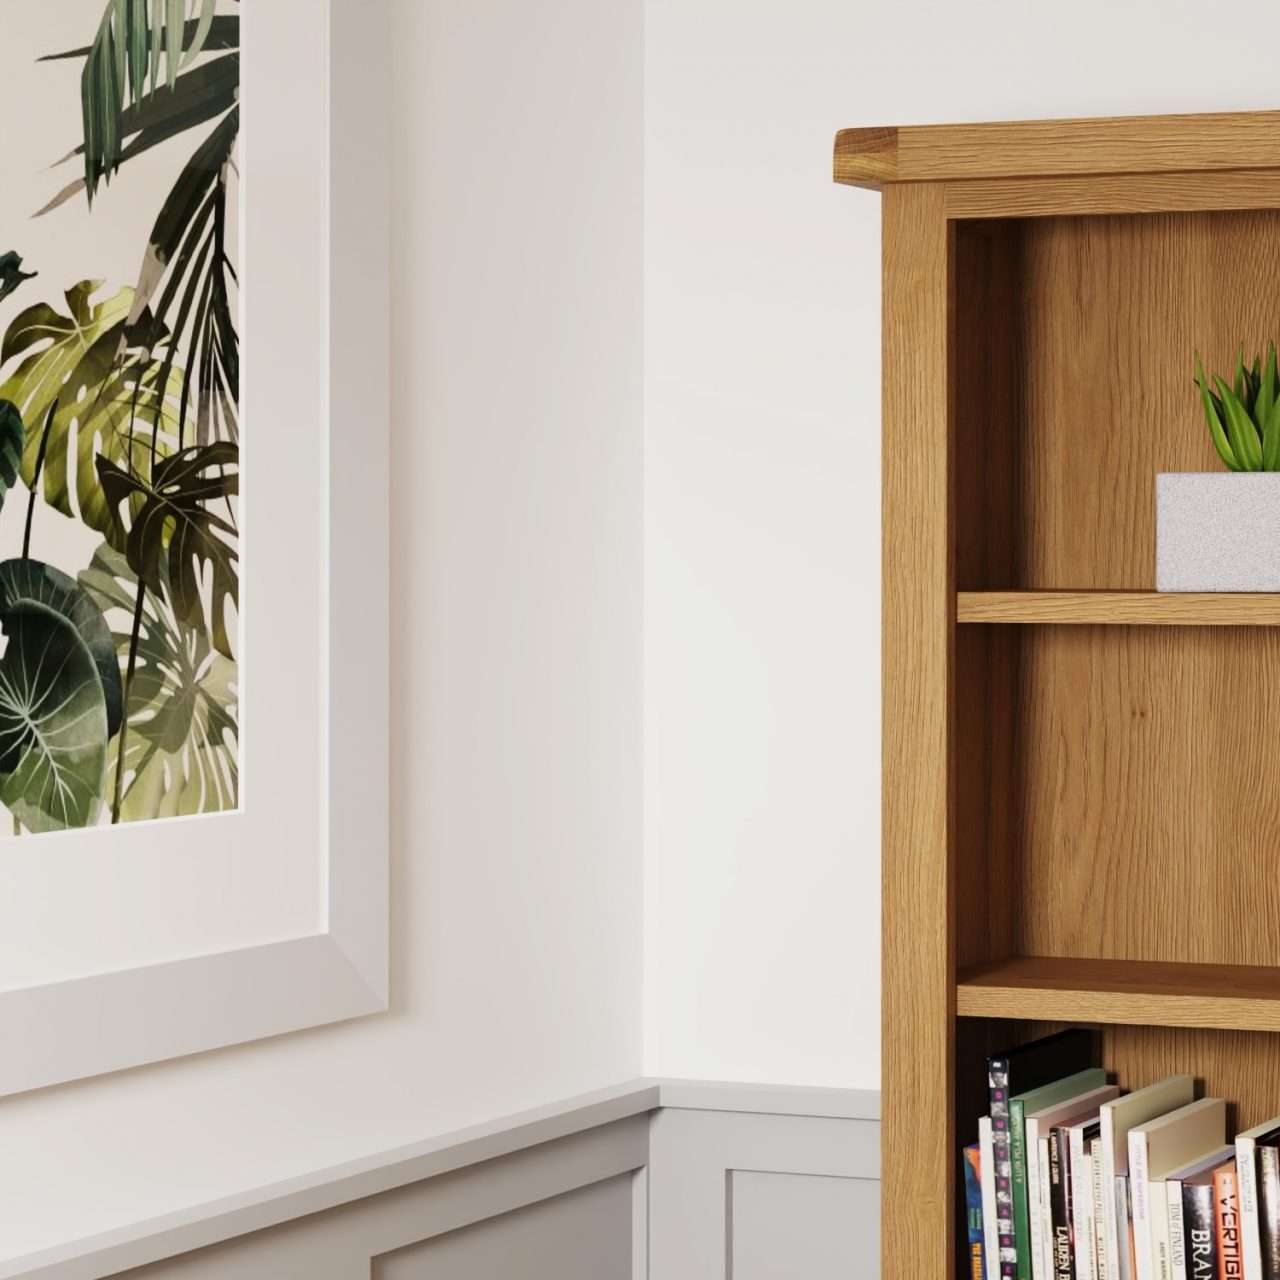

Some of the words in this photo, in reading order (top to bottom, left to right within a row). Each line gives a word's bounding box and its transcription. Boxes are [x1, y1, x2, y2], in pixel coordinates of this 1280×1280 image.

[1170, 1203, 1181, 1221] TOM
[1055, 1226, 1071, 1270] LAUREN
[1171, 1231, 1184, 1266] FINLAND
